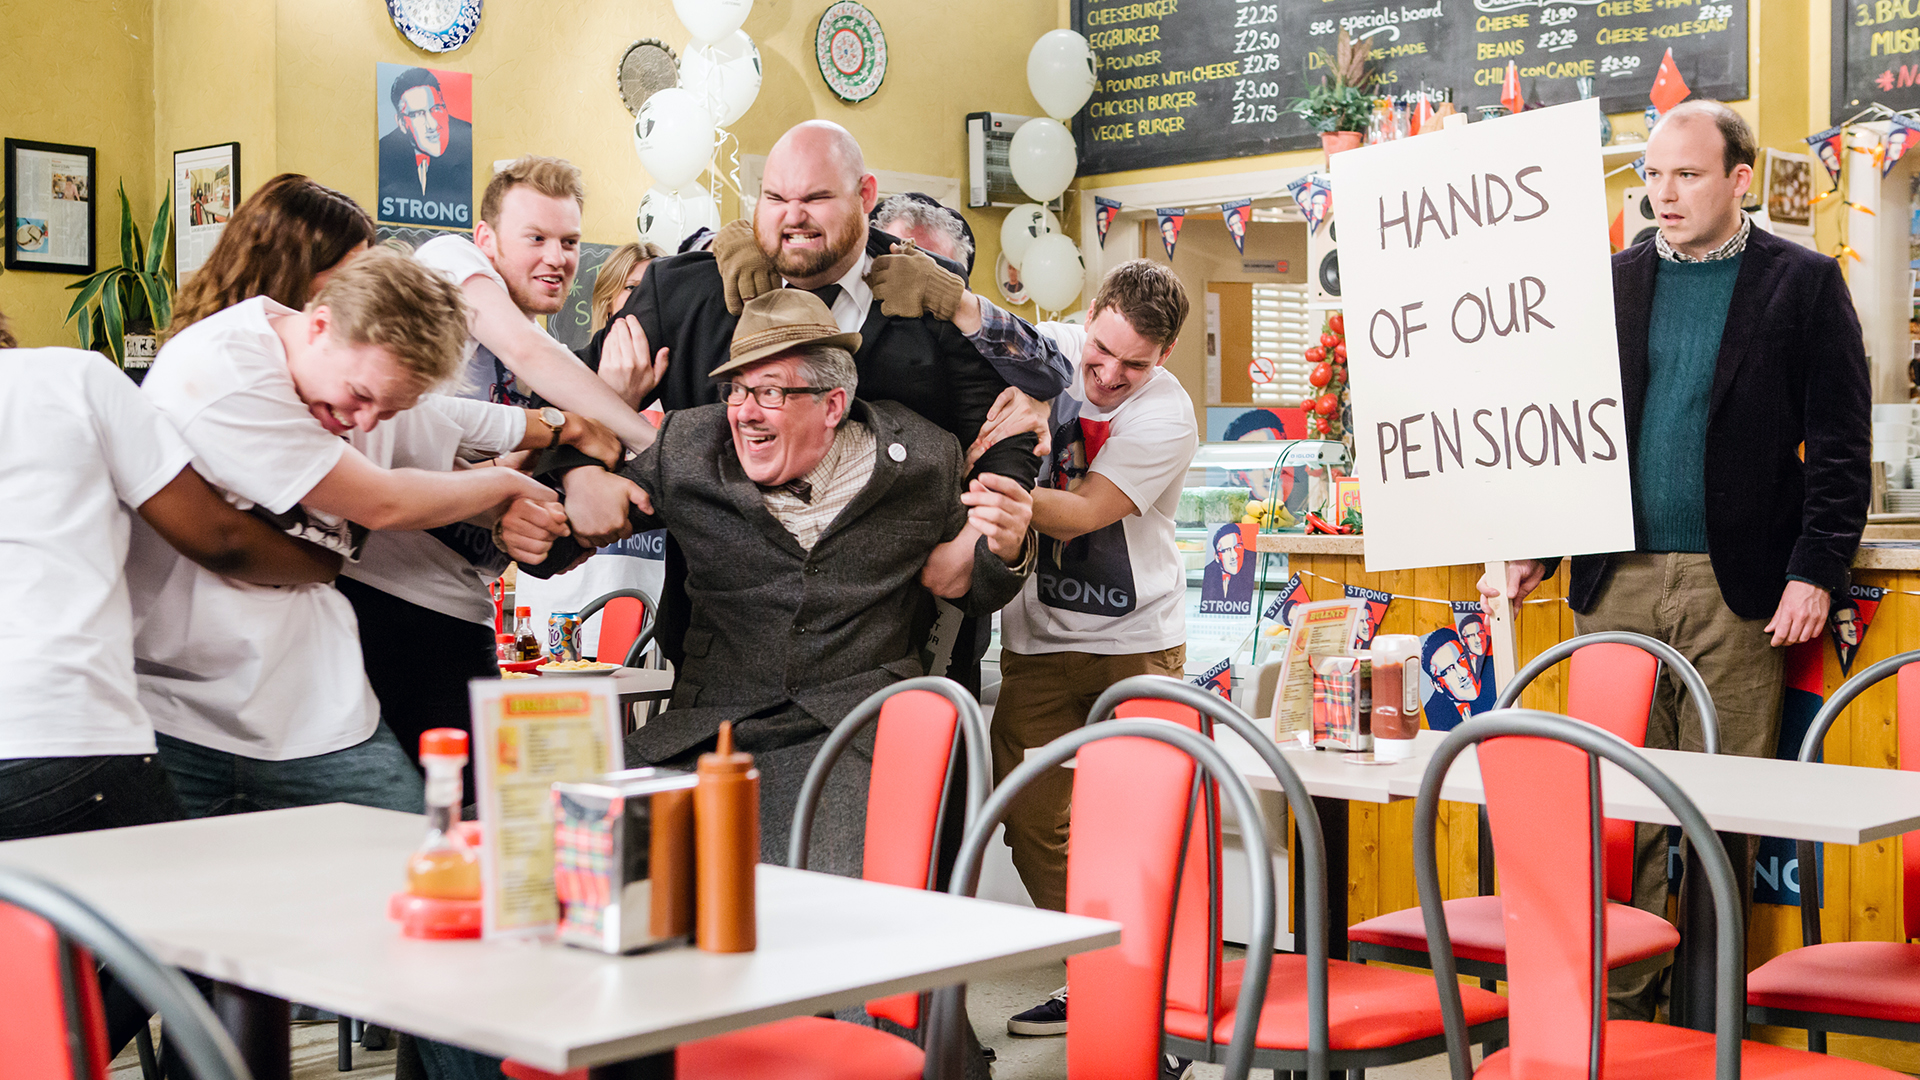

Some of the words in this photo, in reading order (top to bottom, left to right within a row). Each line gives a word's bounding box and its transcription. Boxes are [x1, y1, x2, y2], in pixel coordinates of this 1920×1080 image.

[1087, 0, 1178, 26] CHEESEBURGER
[1309, 19, 1336, 36] see
[1340, 7, 1399, 36] specials
[1400, 0, 1443, 23] board
[1596, 0, 1654, 17] CHEESE
[1476, 14, 1530, 32] CHEESE
[1596, 27, 1649, 45] CHEESE
[1090, 24, 1161, 51] EGGBURGER
[1477, 39, 1525, 61] BEANS
[1106, 50, 1161, 70] POUNDER
[1546, 60, 1595, 79] CARNE
[1106, 74, 1160, 93] POUNDER
[1162, 70, 1191, 86] WITH
[1192, 61, 1242, 81] CHEESE
[1090, 97, 1144, 118] CHICKEN
[1148, 91, 1197, 112] BURGER
[1091, 122, 1134, 142] VEGGIE
[1138, 116, 1185, 136] BURGER
[381, 196, 468, 223] STRONG
[1377, 166, 1549, 249] HANDS
[1369, 301, 1427, 359] OF
[1451, 276, 1555, 344] OUR
[1376, 398, 1617, 484] PENSIONS
[1201, 600, 1250, 613] STRONG
[1268, 577, 1299, 617] STRONG
[1347, 585, 1388, 602] STRONG
